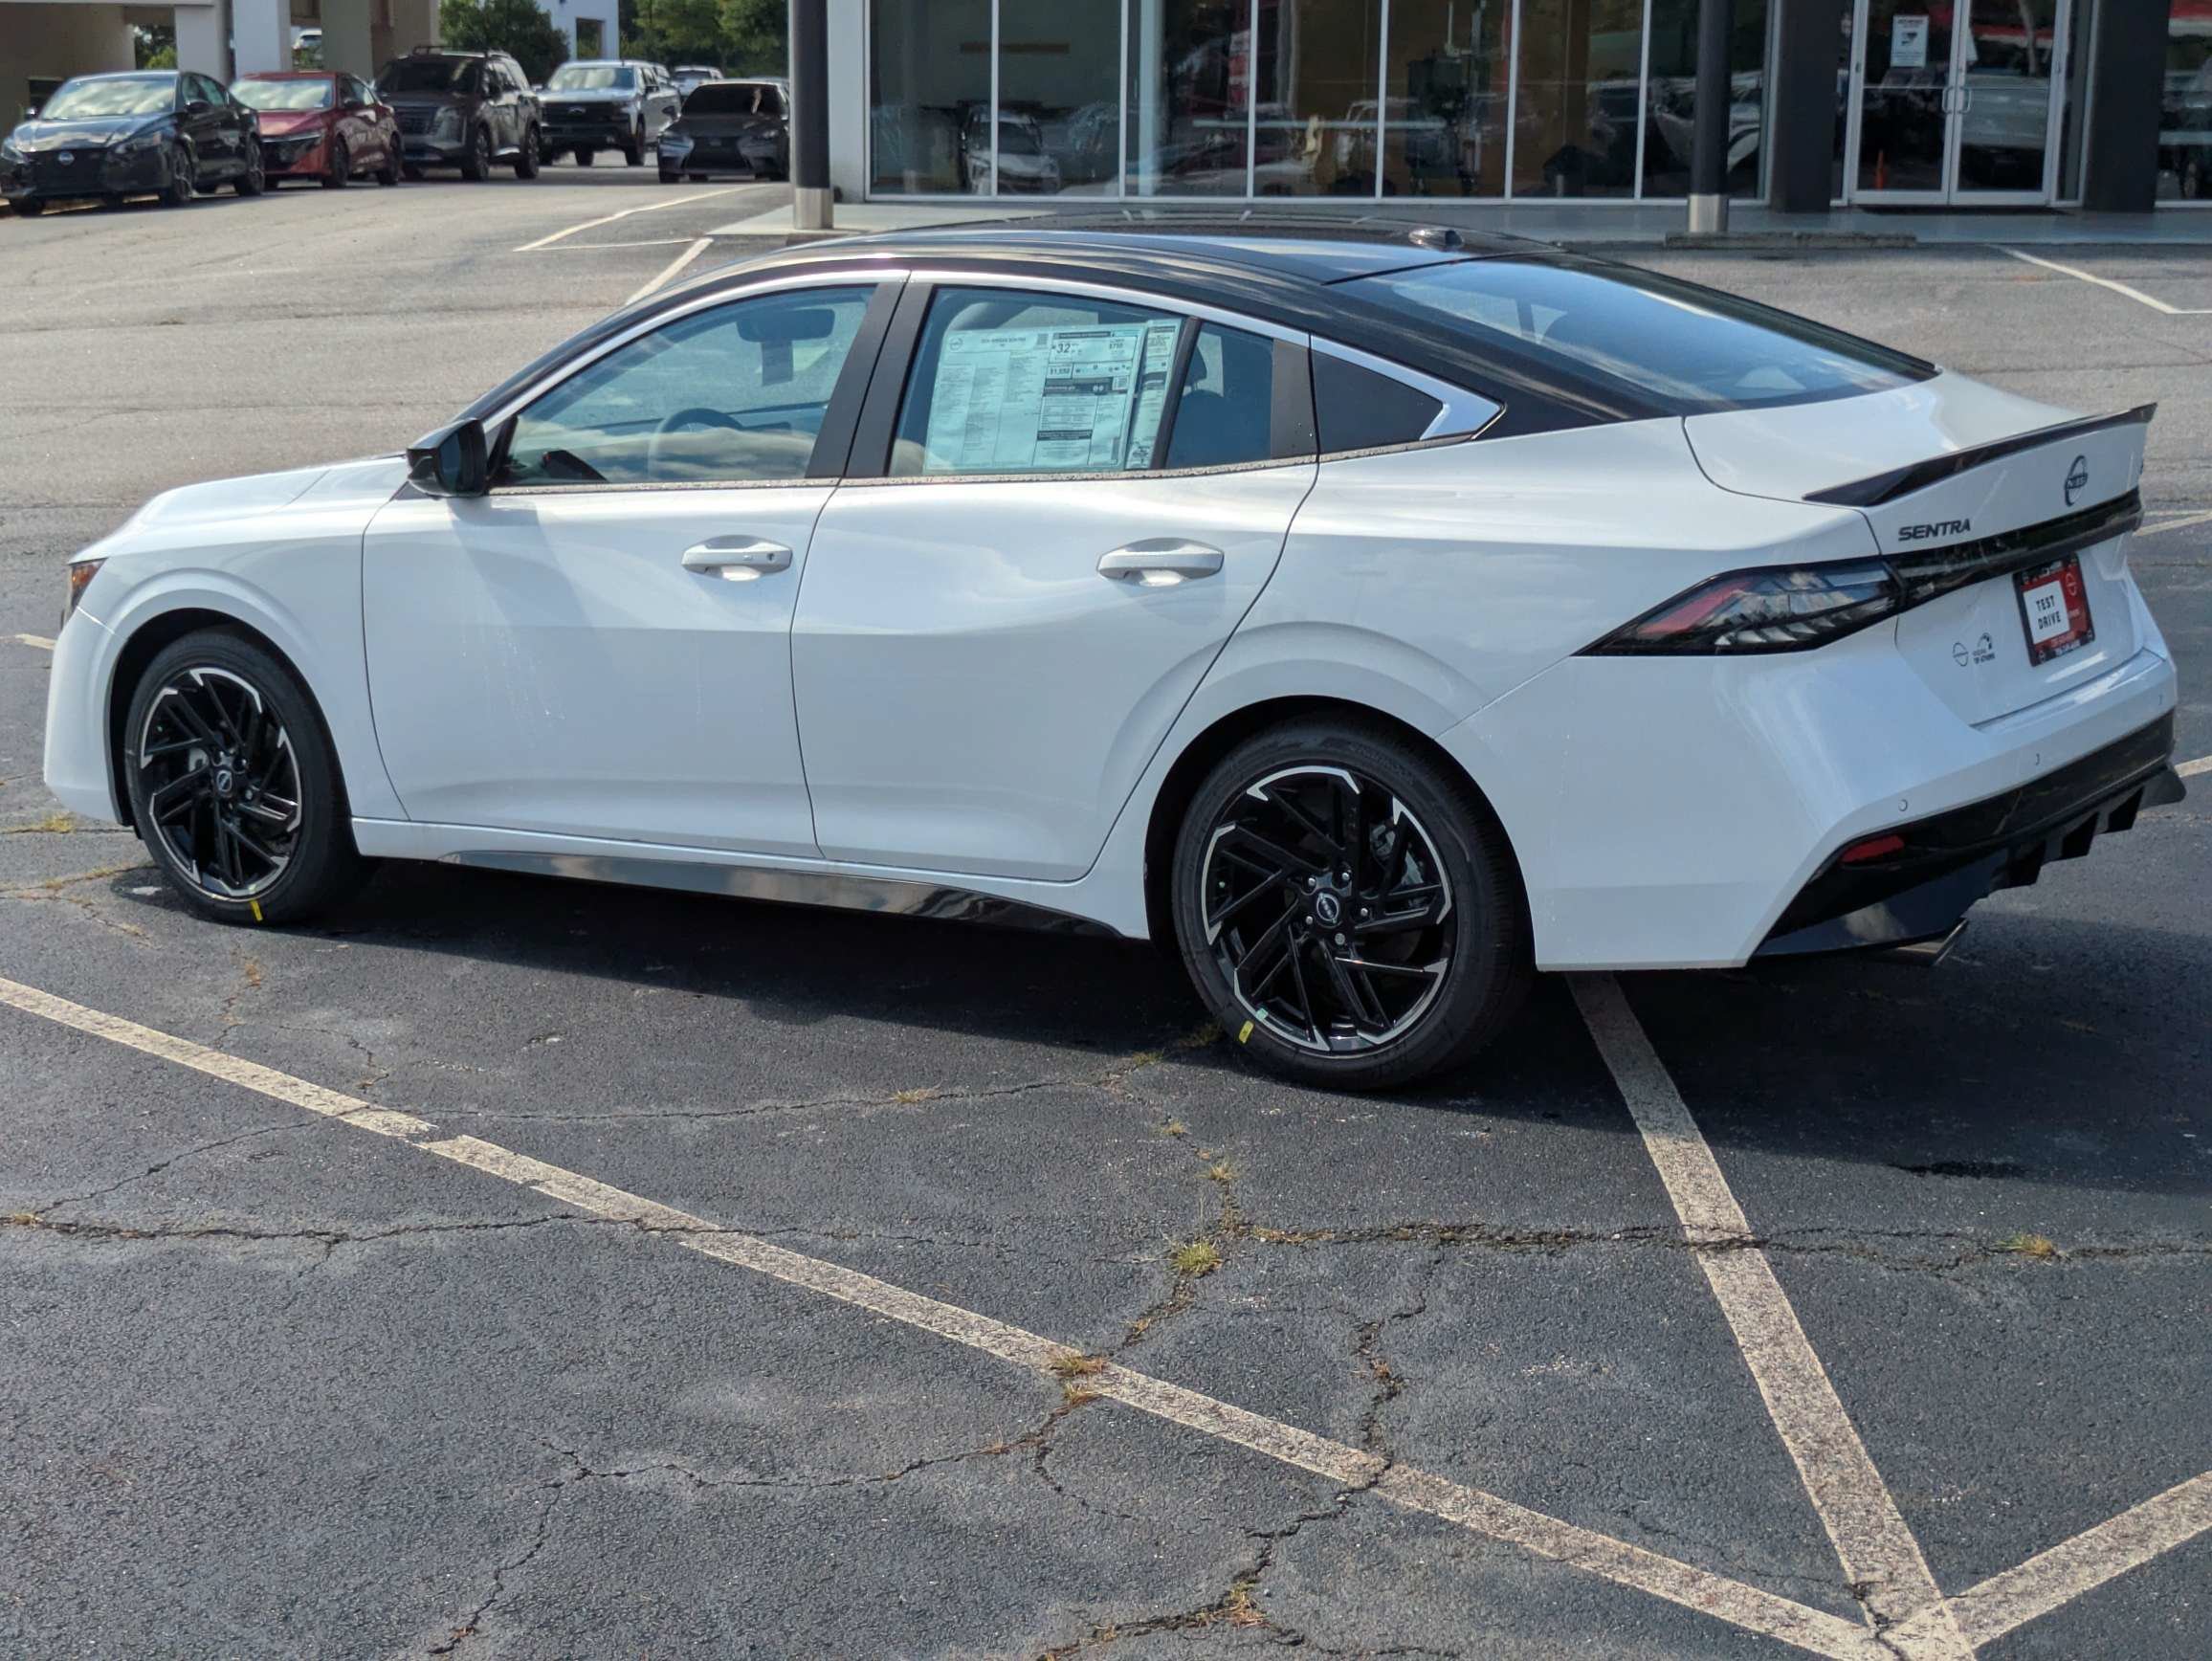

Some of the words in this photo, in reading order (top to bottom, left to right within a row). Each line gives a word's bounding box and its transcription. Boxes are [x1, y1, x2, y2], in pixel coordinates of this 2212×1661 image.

[1056, 343, 1072, 355] 32
[1898, 519, 1970, 542] SENTRA
[2036, 595, 2055, 611] TEST
[2038, 611, 2061, 630] DRIVE
